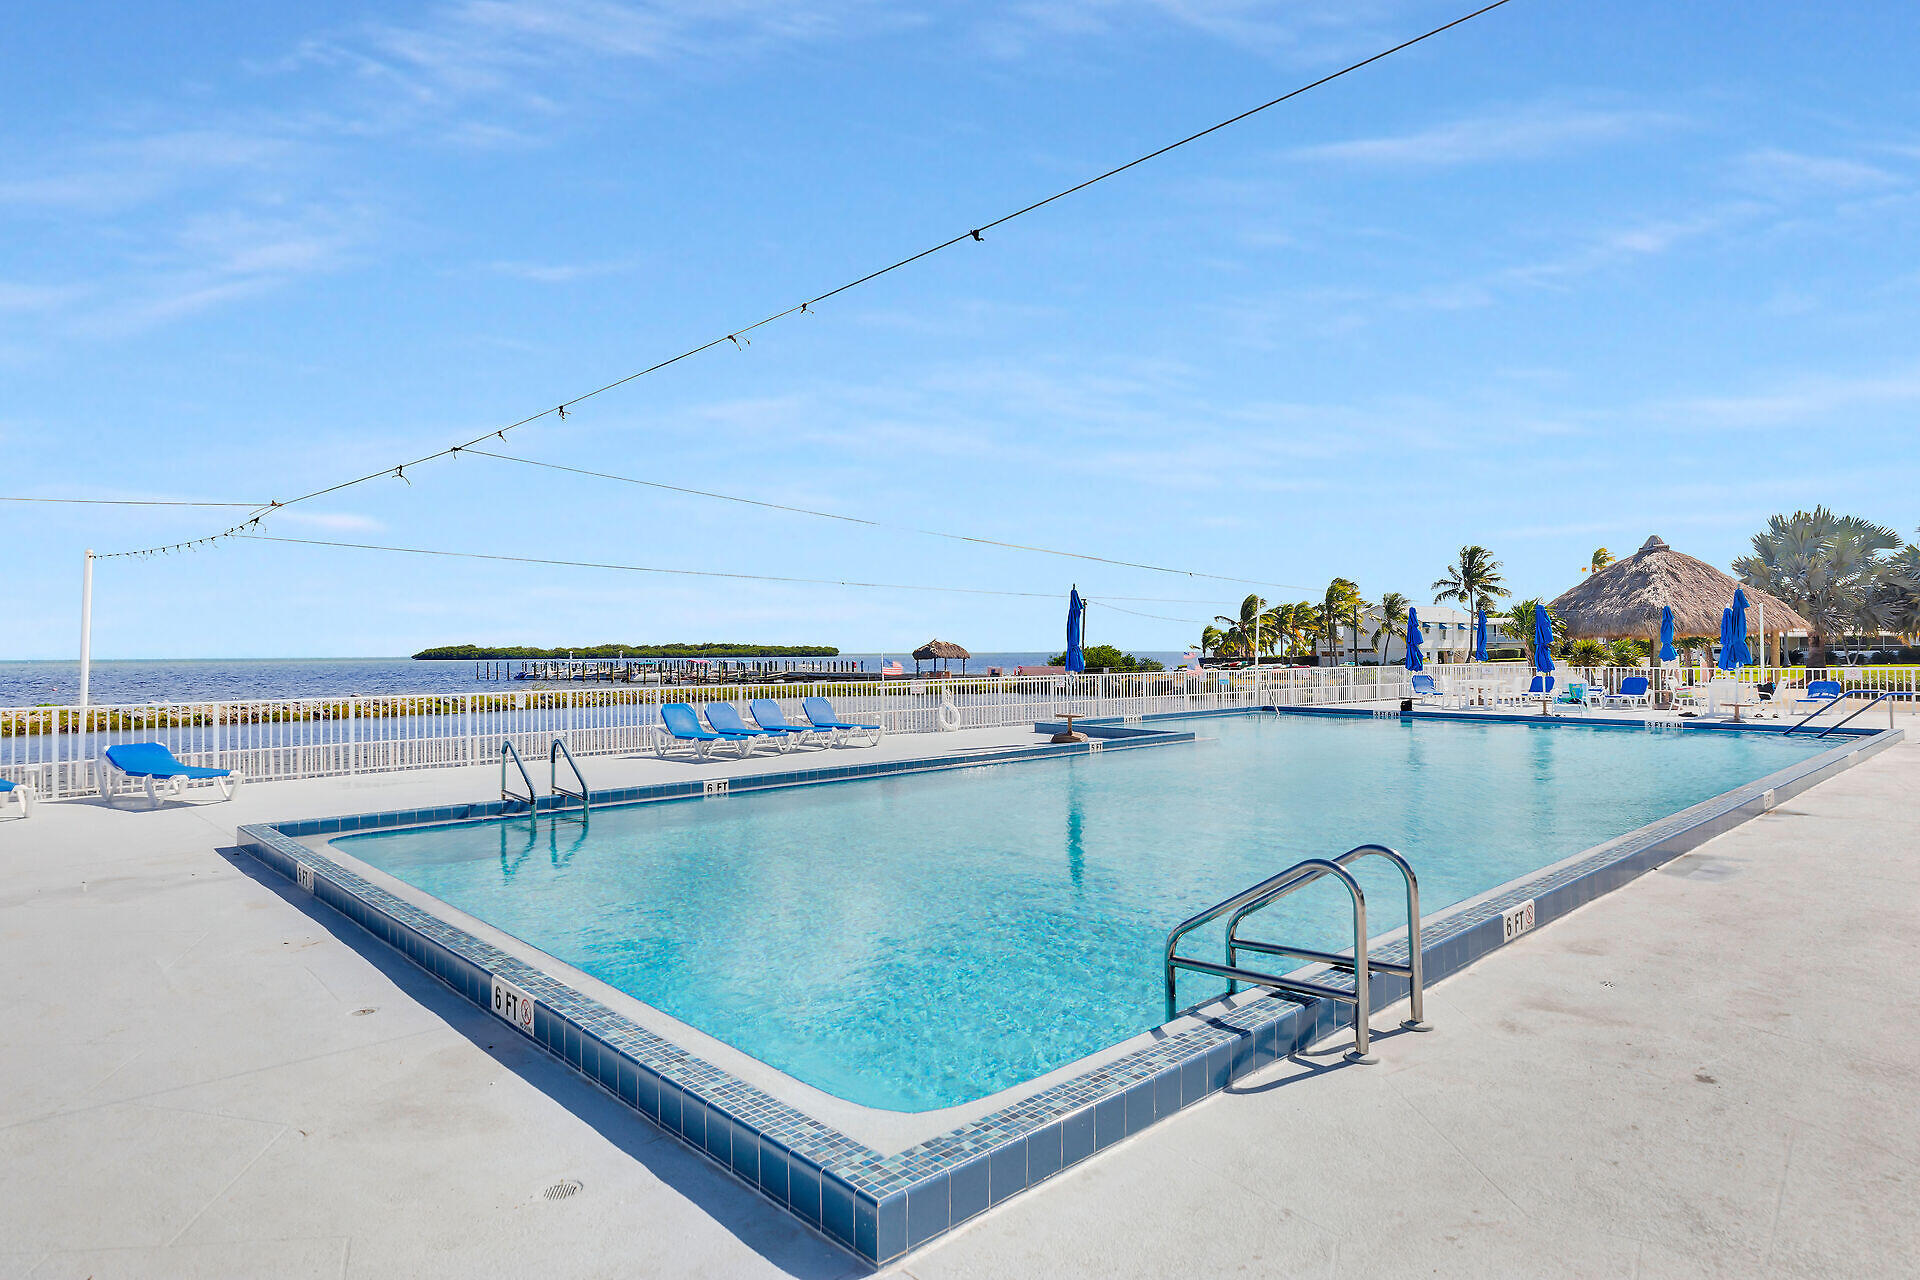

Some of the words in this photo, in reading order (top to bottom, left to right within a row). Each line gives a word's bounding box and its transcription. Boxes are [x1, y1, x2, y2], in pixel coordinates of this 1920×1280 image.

[707, 783, 713, 792] 6
[717, 782, 727, 791] FT
[1506, 916, 1512, 937] 6
[1514, 910, 1524, 934] FT
[495, 985, 502, 1010] 6
[505, 991, 517, 1021] FT
